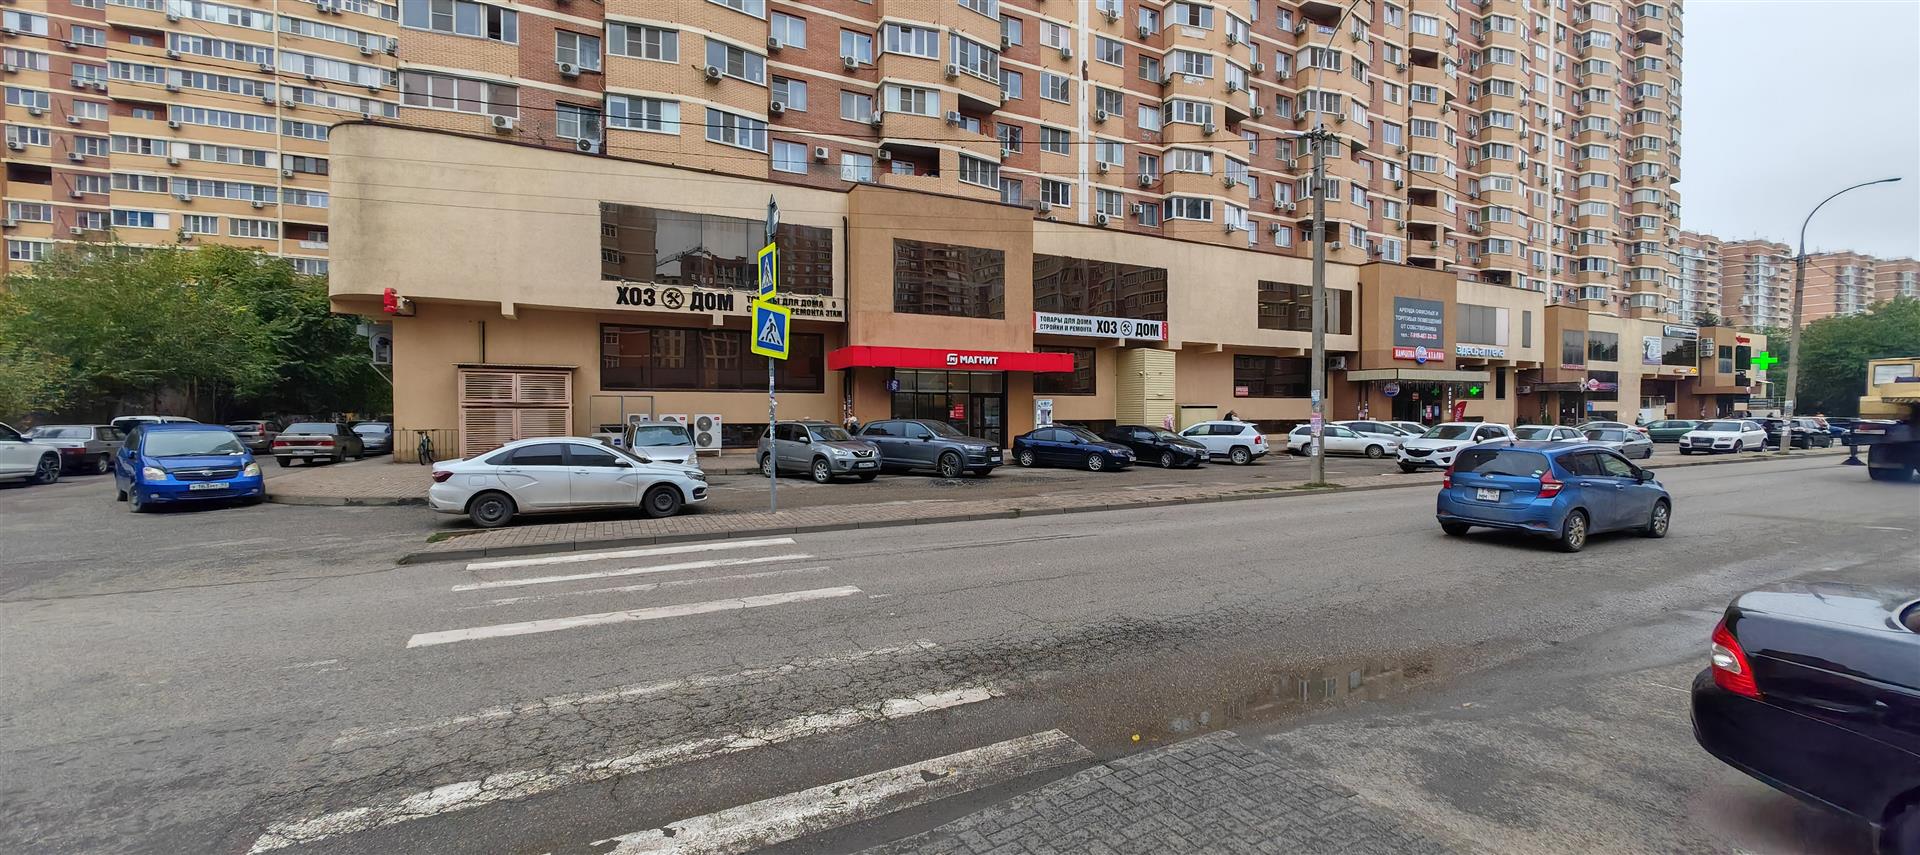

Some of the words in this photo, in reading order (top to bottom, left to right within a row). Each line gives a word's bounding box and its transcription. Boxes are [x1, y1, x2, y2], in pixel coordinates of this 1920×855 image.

[616, 286, 656, 307] ХОЗ
[690, 291, 734, 312] ДОМ
[782, 298, 800, 307] ДЛЯ
[801, 299, 824, 308] ДОМА
[791, 307, 824, 317] РЕМОНТА
[825, 309, 843, 318] ЭТАЖ
[1040, 315, 1063, 323] ТОВАРЫ
[1063, 317, 1076, 325] ДЛЯ
[1069, 325, 1092, 333] РЕМОНТА
[1096, 320, 1118, 334] ХОЗ
[1135, 322, 1160, 337] ДОМ
[959, 355, 998, 365] МАГНИТ
